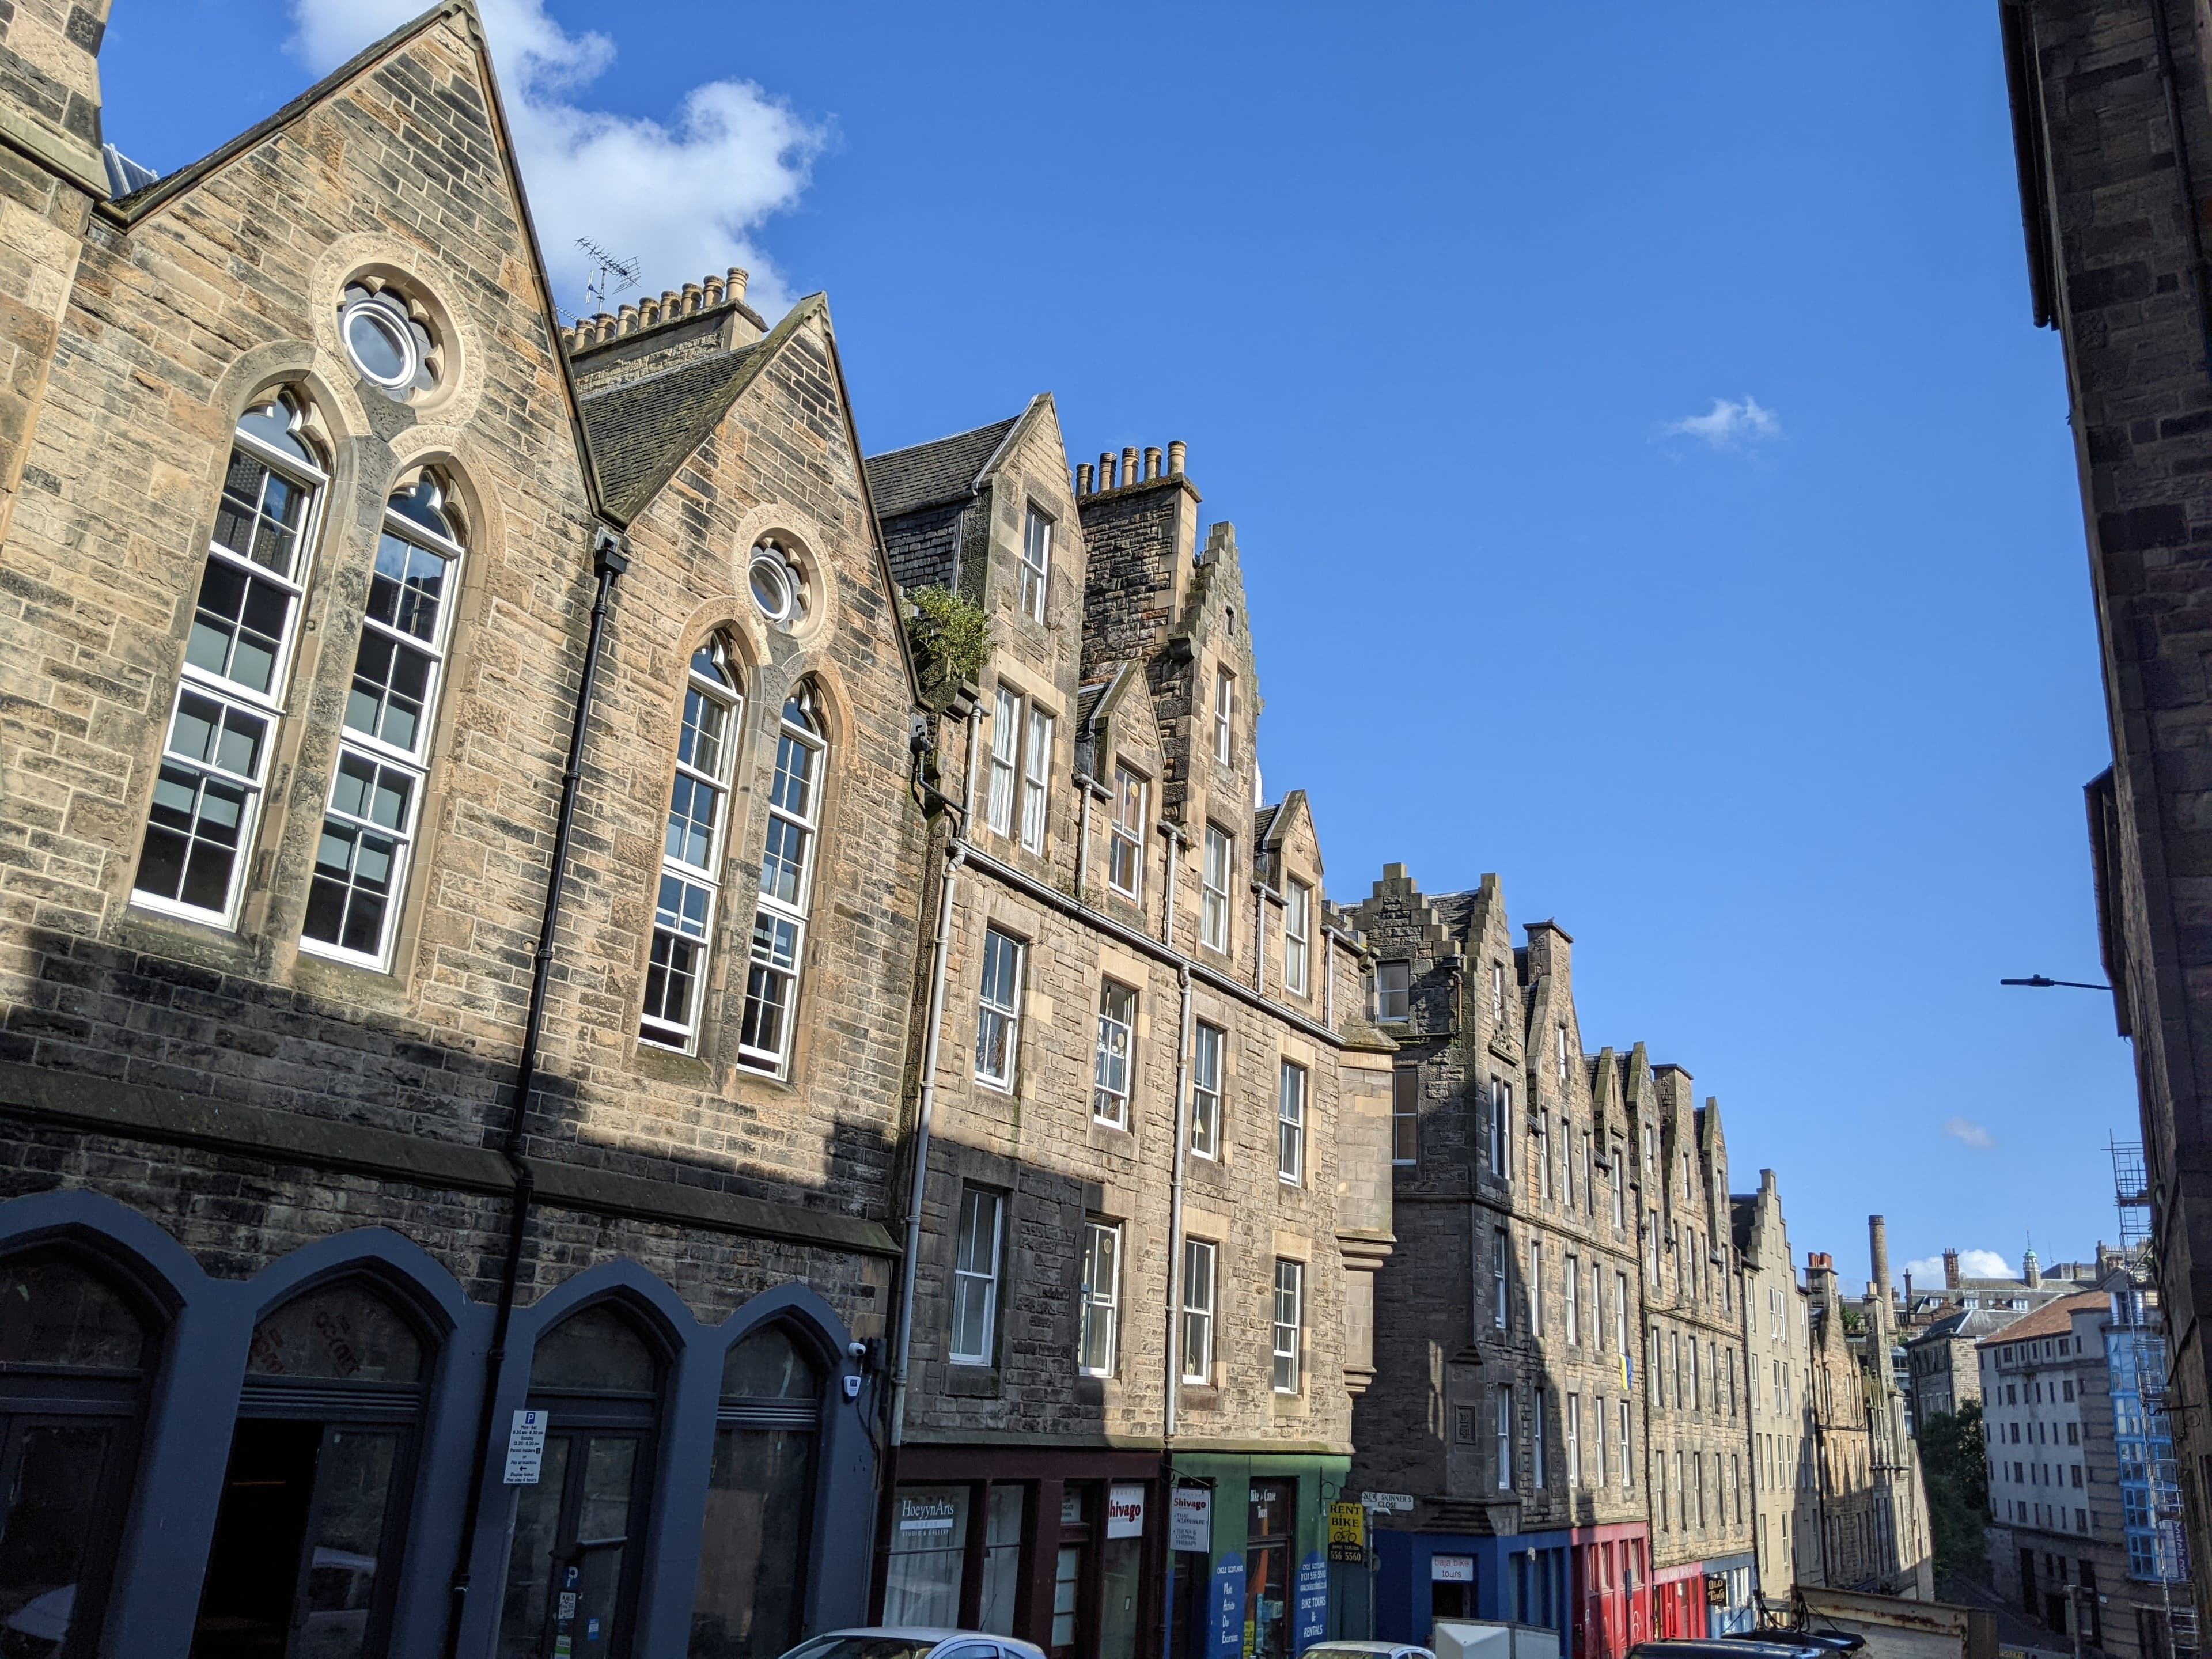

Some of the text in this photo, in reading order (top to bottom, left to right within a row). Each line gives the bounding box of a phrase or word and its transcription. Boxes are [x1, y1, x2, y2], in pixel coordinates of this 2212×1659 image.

[527, 1413, 535, 1423] P
[902, 1499, 954, 1520] HoeyynArts
[1174, 1498, 1206, 1511] Shivago
[1109, 1499, 1141, 1522] hivago
[1330, 1505, 1360, 1515] RENT
[1345, 1551, 1361, 1562] 5560
[1434, 1558, 1469, 1568] baja bike
[1228, 1565, 1244, 1573] SCOTLAND
[1442, 1570, 1462, 1578] tours
[1300, 1573, 1310, 1581] 0131
[1709, 1580, 1724, 1590] OLD
[1301, 1596, 1326, 1609] BIKE TOURS
[1311, 1612, 1316, 1622] &
[1304, 1624, 1323, 1638] RENTALS
